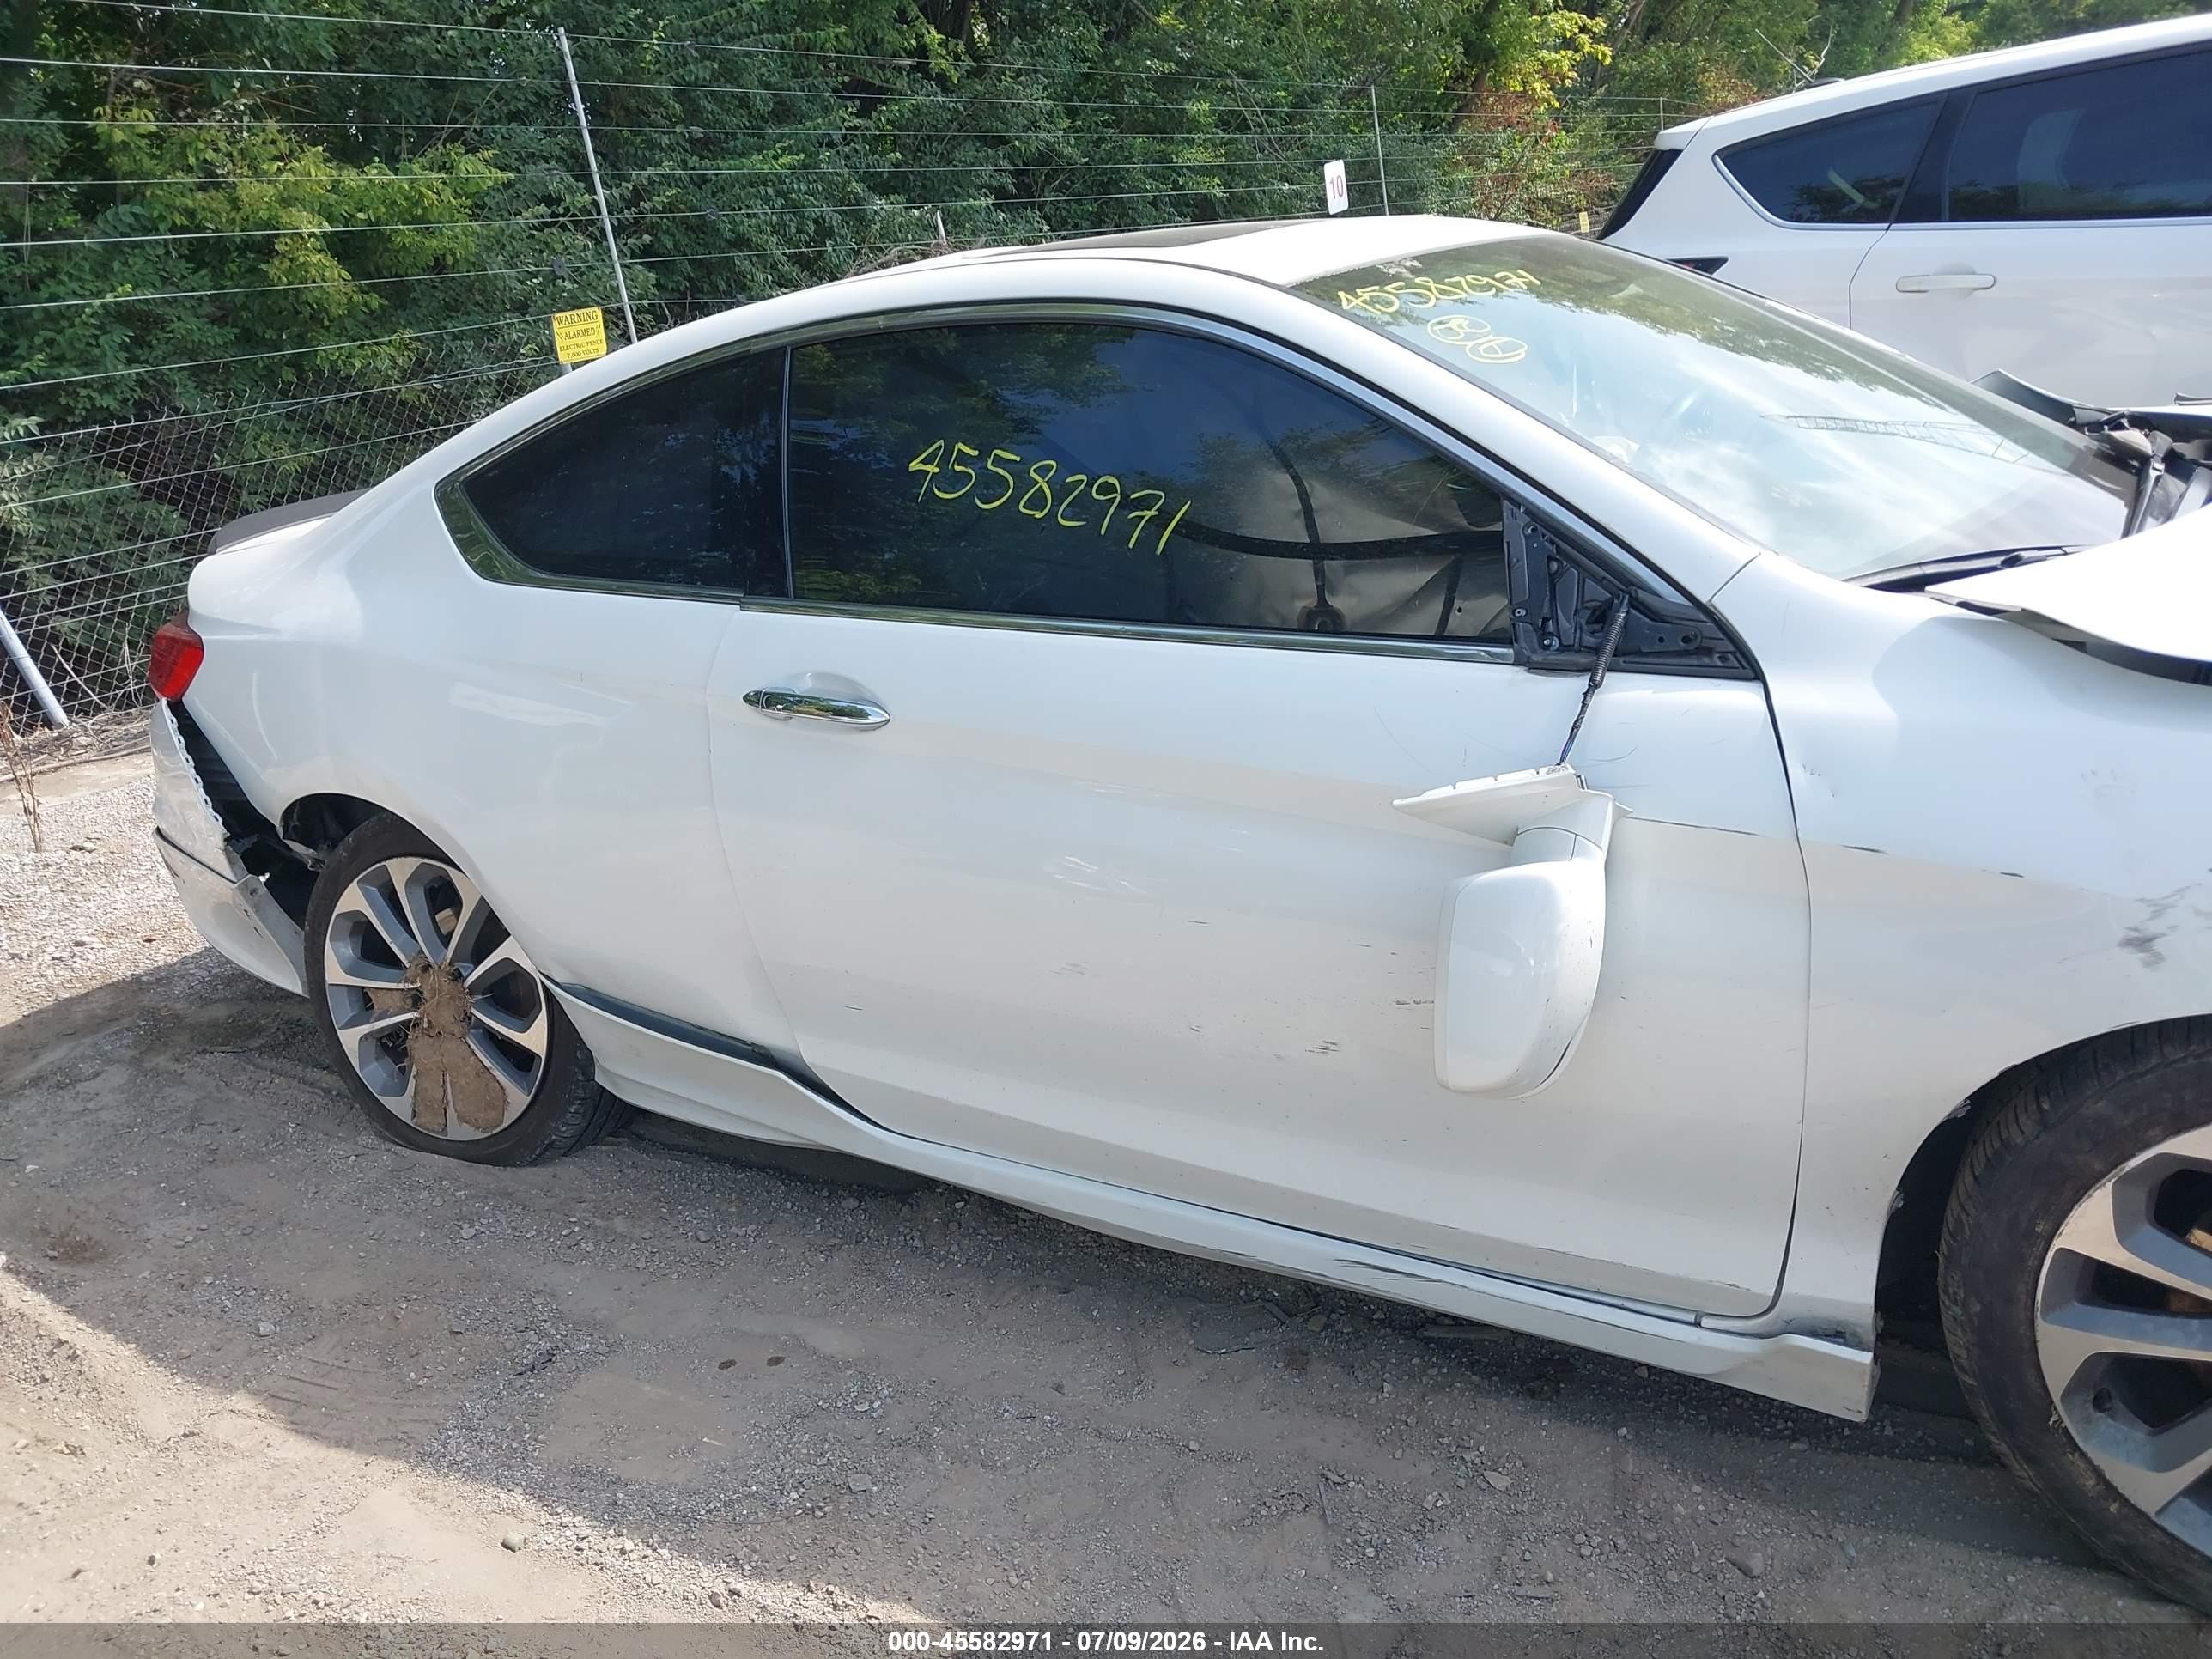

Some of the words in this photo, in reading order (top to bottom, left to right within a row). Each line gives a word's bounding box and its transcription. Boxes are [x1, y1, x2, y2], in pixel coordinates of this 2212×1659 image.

[1329, 175, 1344, 199] 10
[1338, 270, 1540, 314] 45582971
[553, 310, 599, 326] WARNING
[564, 327, 596, 340] ALARMED
[560, 342, 586, 351] ELECTRIC
[908, 440, 1191, 556] 45582971
